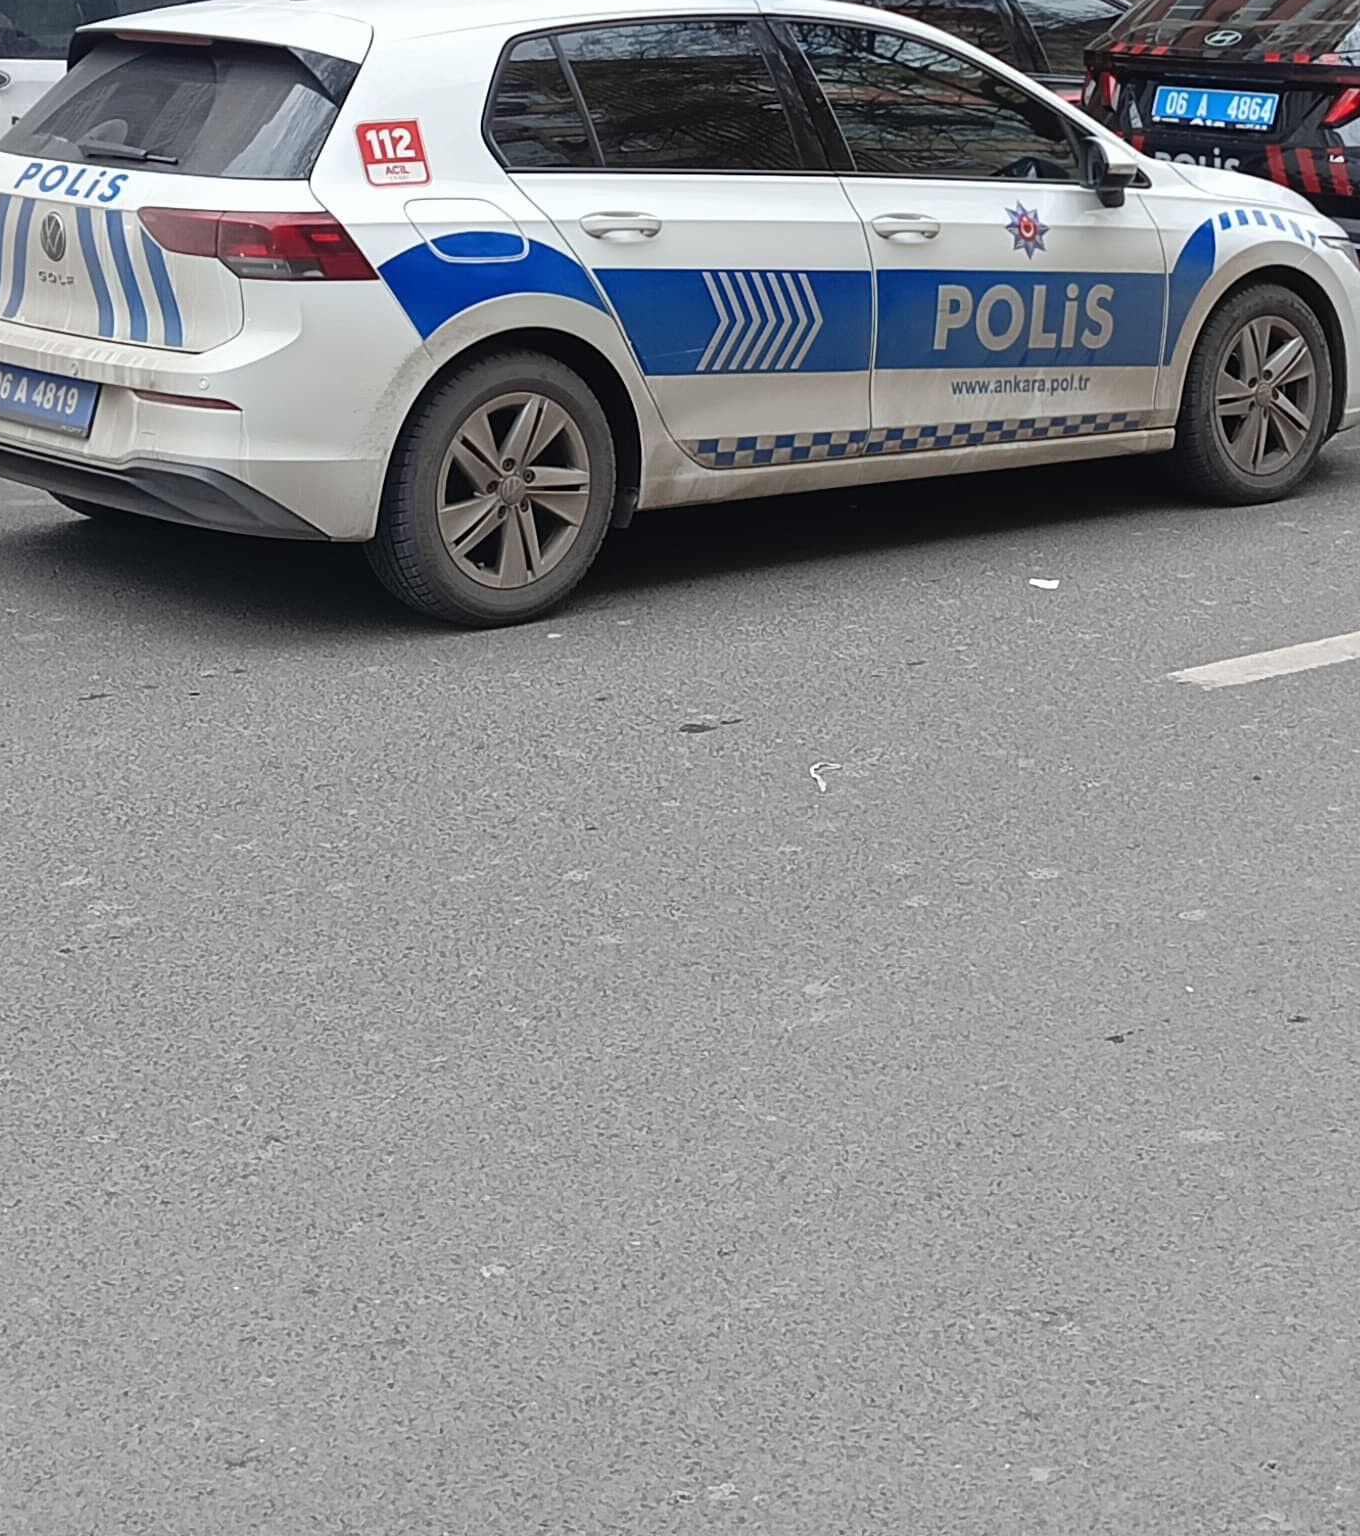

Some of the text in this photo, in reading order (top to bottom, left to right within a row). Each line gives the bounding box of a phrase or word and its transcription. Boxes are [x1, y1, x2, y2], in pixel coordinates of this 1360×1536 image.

[1165, 91, 1274, 123] 06 A 4864
[365, 128, 417, 160] 112
[14, 376, 29, 404] A
[31, 380, 79, 415] 4819
[951, 373, 1091, 396] www.ankara.pol.tr
